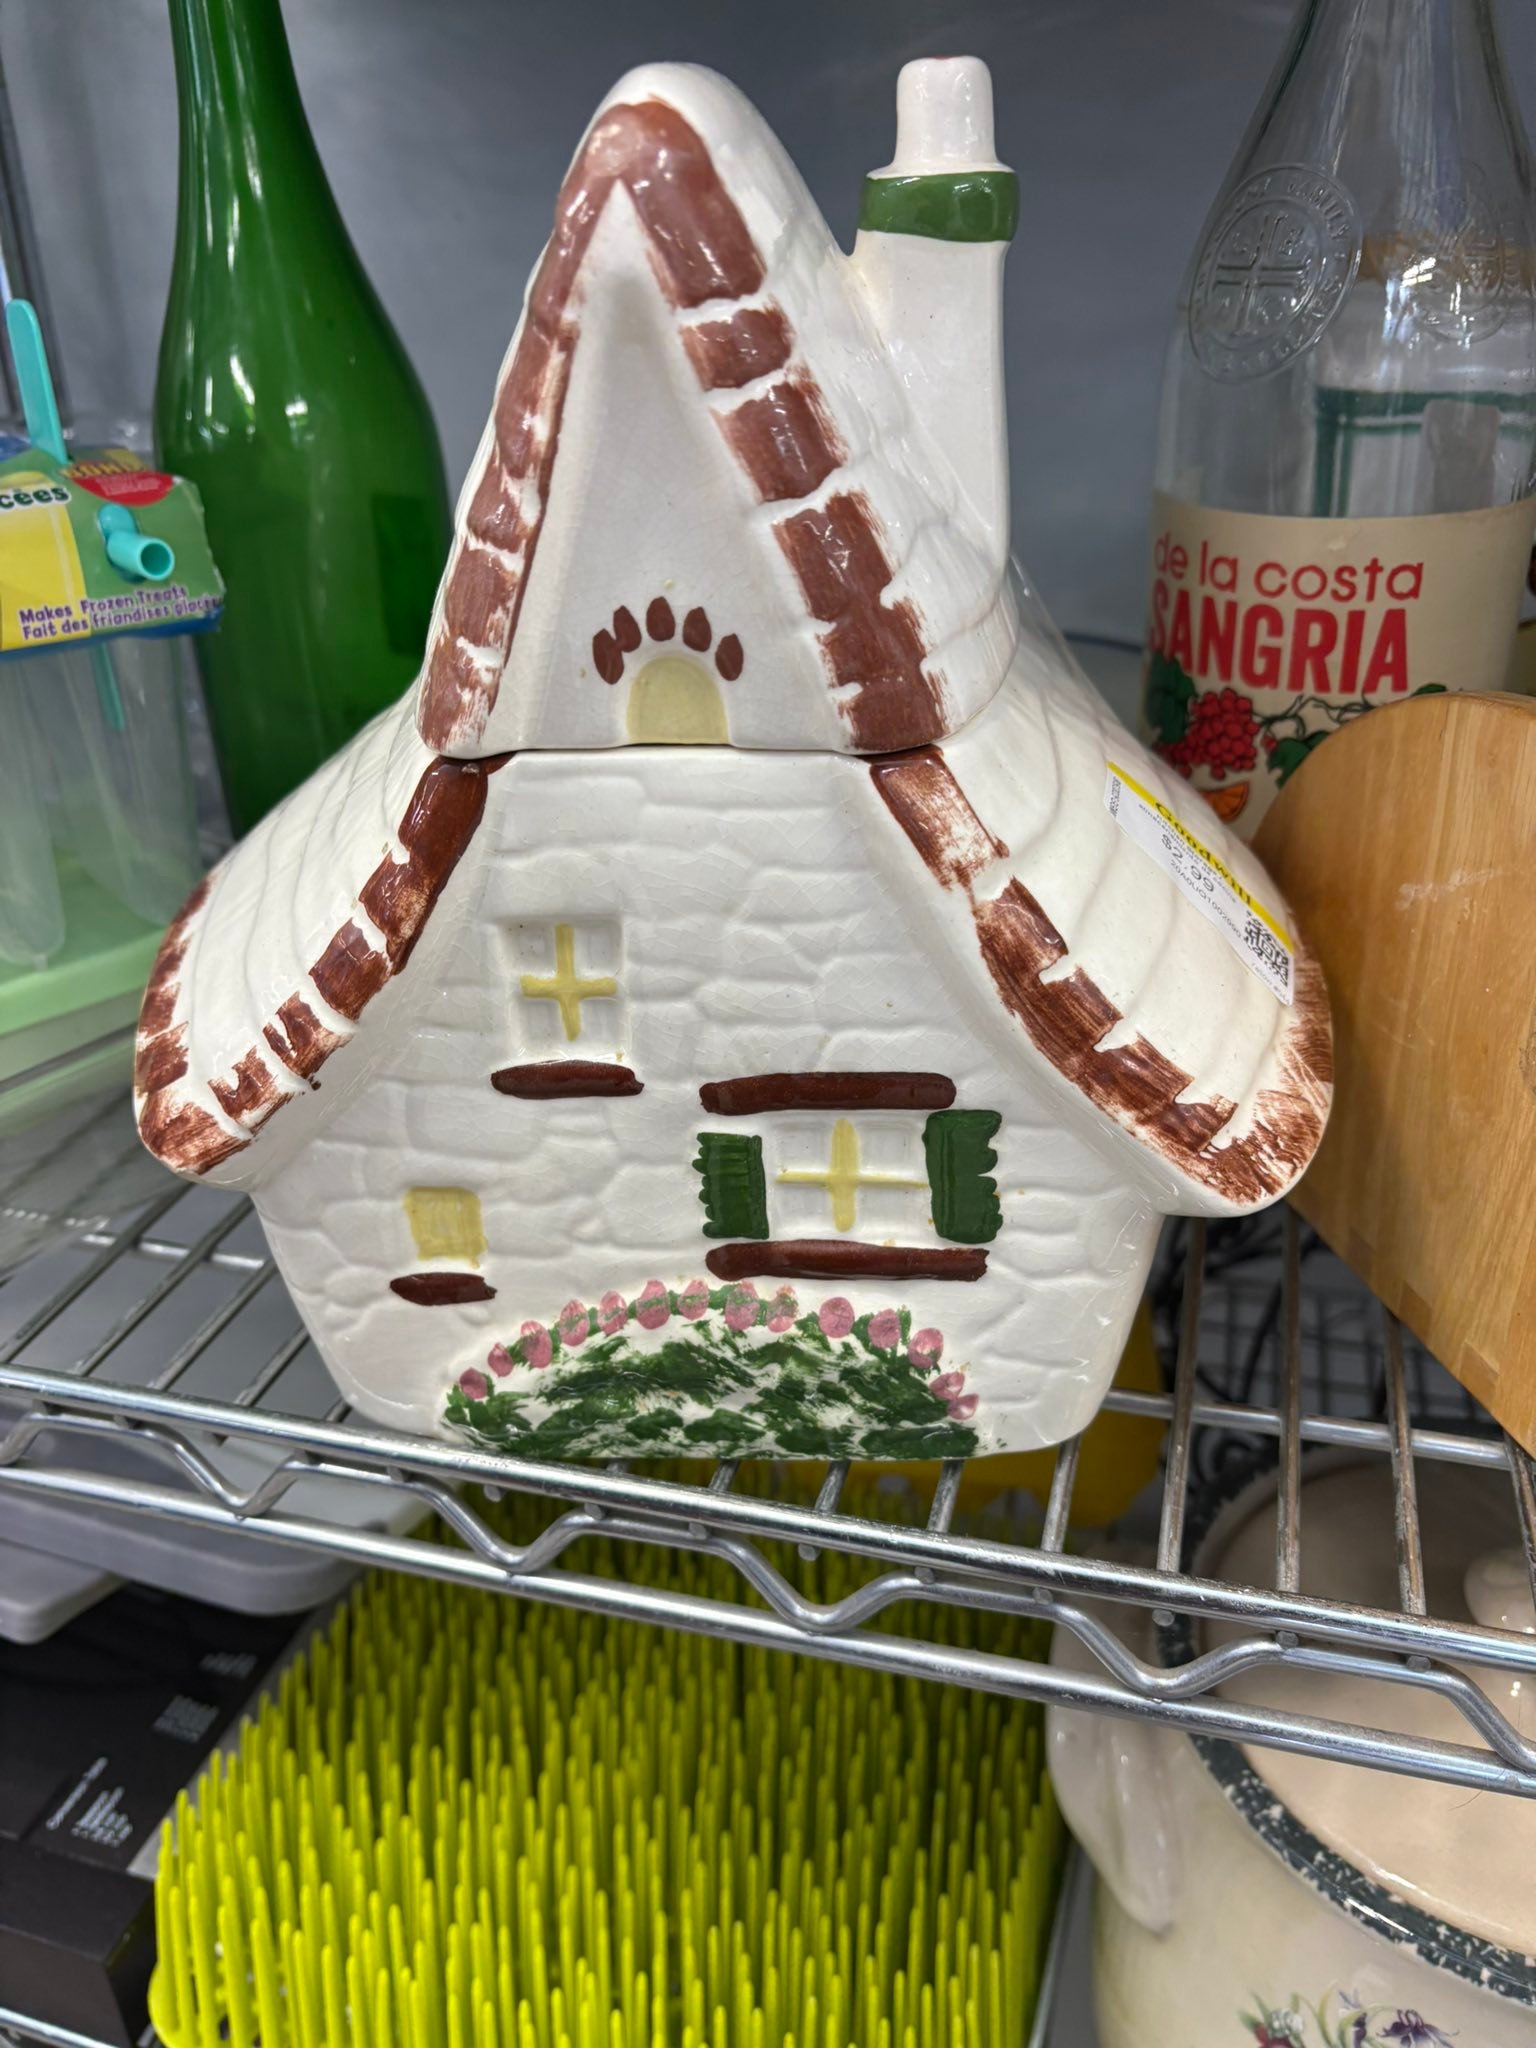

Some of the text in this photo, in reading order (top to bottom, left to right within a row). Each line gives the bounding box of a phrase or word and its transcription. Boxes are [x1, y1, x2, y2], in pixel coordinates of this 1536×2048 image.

[1154, 530, 1424, 602] de la costa
[19, 584, 188, 626] Makes Frozen Treats
[22, 620, 57, 641] Fait
[61, 616, 88, 635] des
[91, 602, 170, 629] friandises
[1149, 578, 1409, 694] SANGRIA
[1155, 802, 1251, 905] Goodwill
[1161, 833, 1215, 892] $2.99
